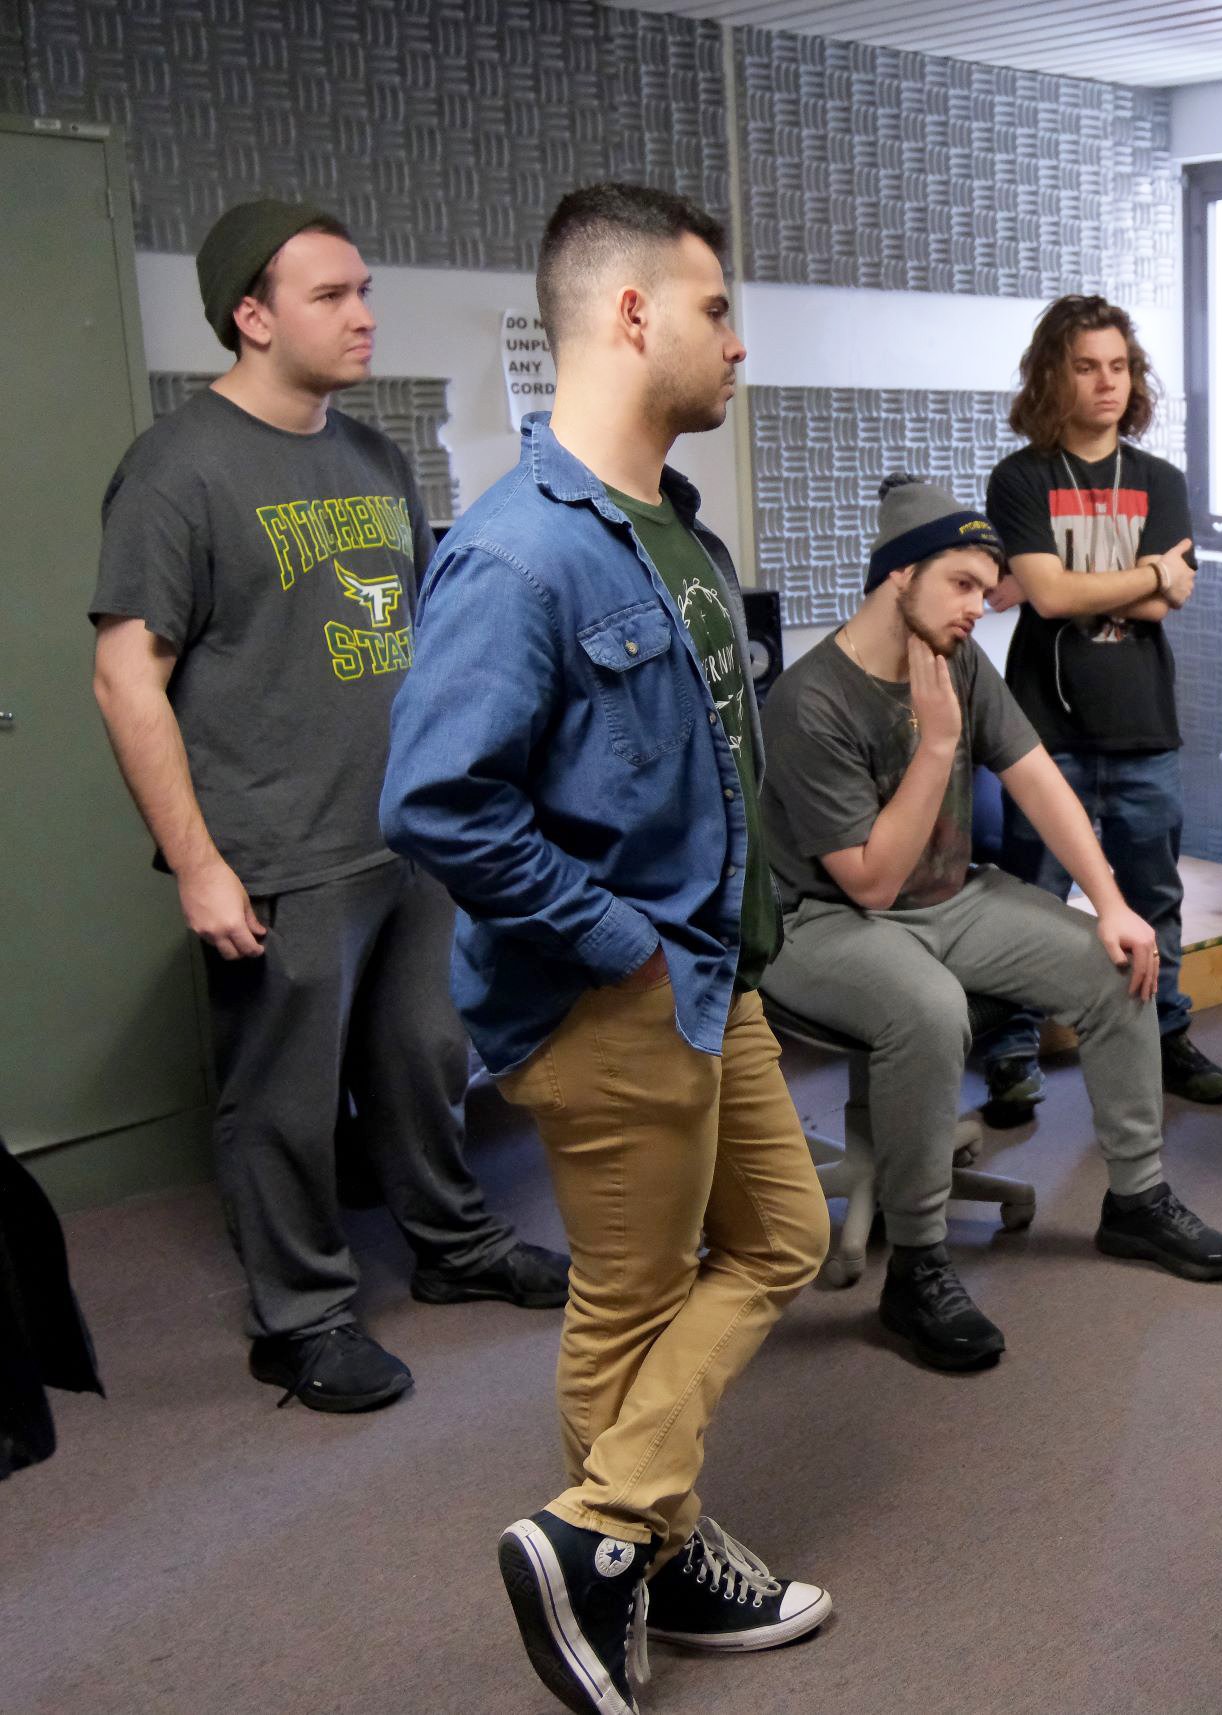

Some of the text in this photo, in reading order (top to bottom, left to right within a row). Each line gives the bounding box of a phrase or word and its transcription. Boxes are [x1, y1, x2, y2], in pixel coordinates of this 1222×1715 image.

[506, 317, 545, 329] DO N
[506, 339, 551, 352] UNPL
[509, 361, 542, 373] ANY
[511, 382, 557, 395] CORD
[256, 496, 413, 591] FITCHBUR
[324, 620, 413, 681] STAT
